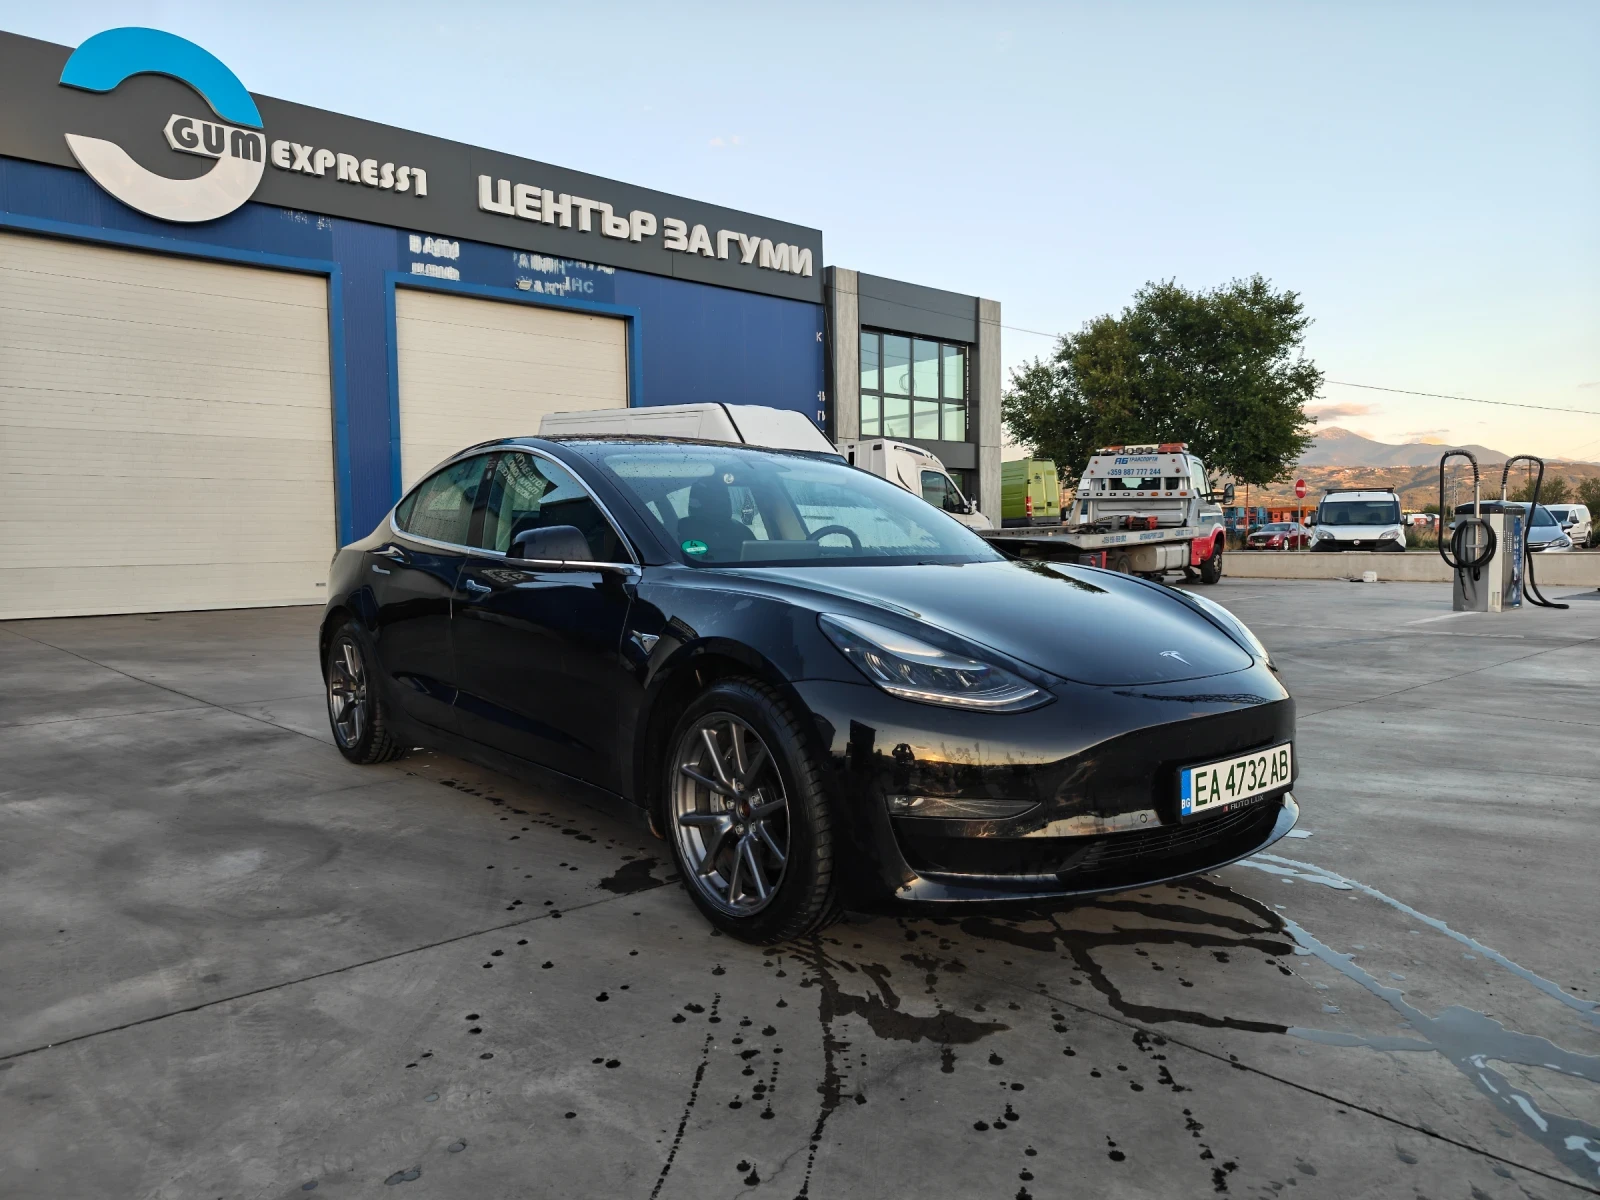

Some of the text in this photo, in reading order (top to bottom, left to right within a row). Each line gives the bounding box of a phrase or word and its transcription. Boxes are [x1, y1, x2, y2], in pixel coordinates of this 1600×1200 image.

[172, 118, 262, 163] GUM
[478, 174, 813, 278] ЦЕНТЪР ЗА ГУМИ
[1181, 750, 1288, 809] BG EA 4732 AB
[1230, 794, 1264, 810] AUTO LUX
